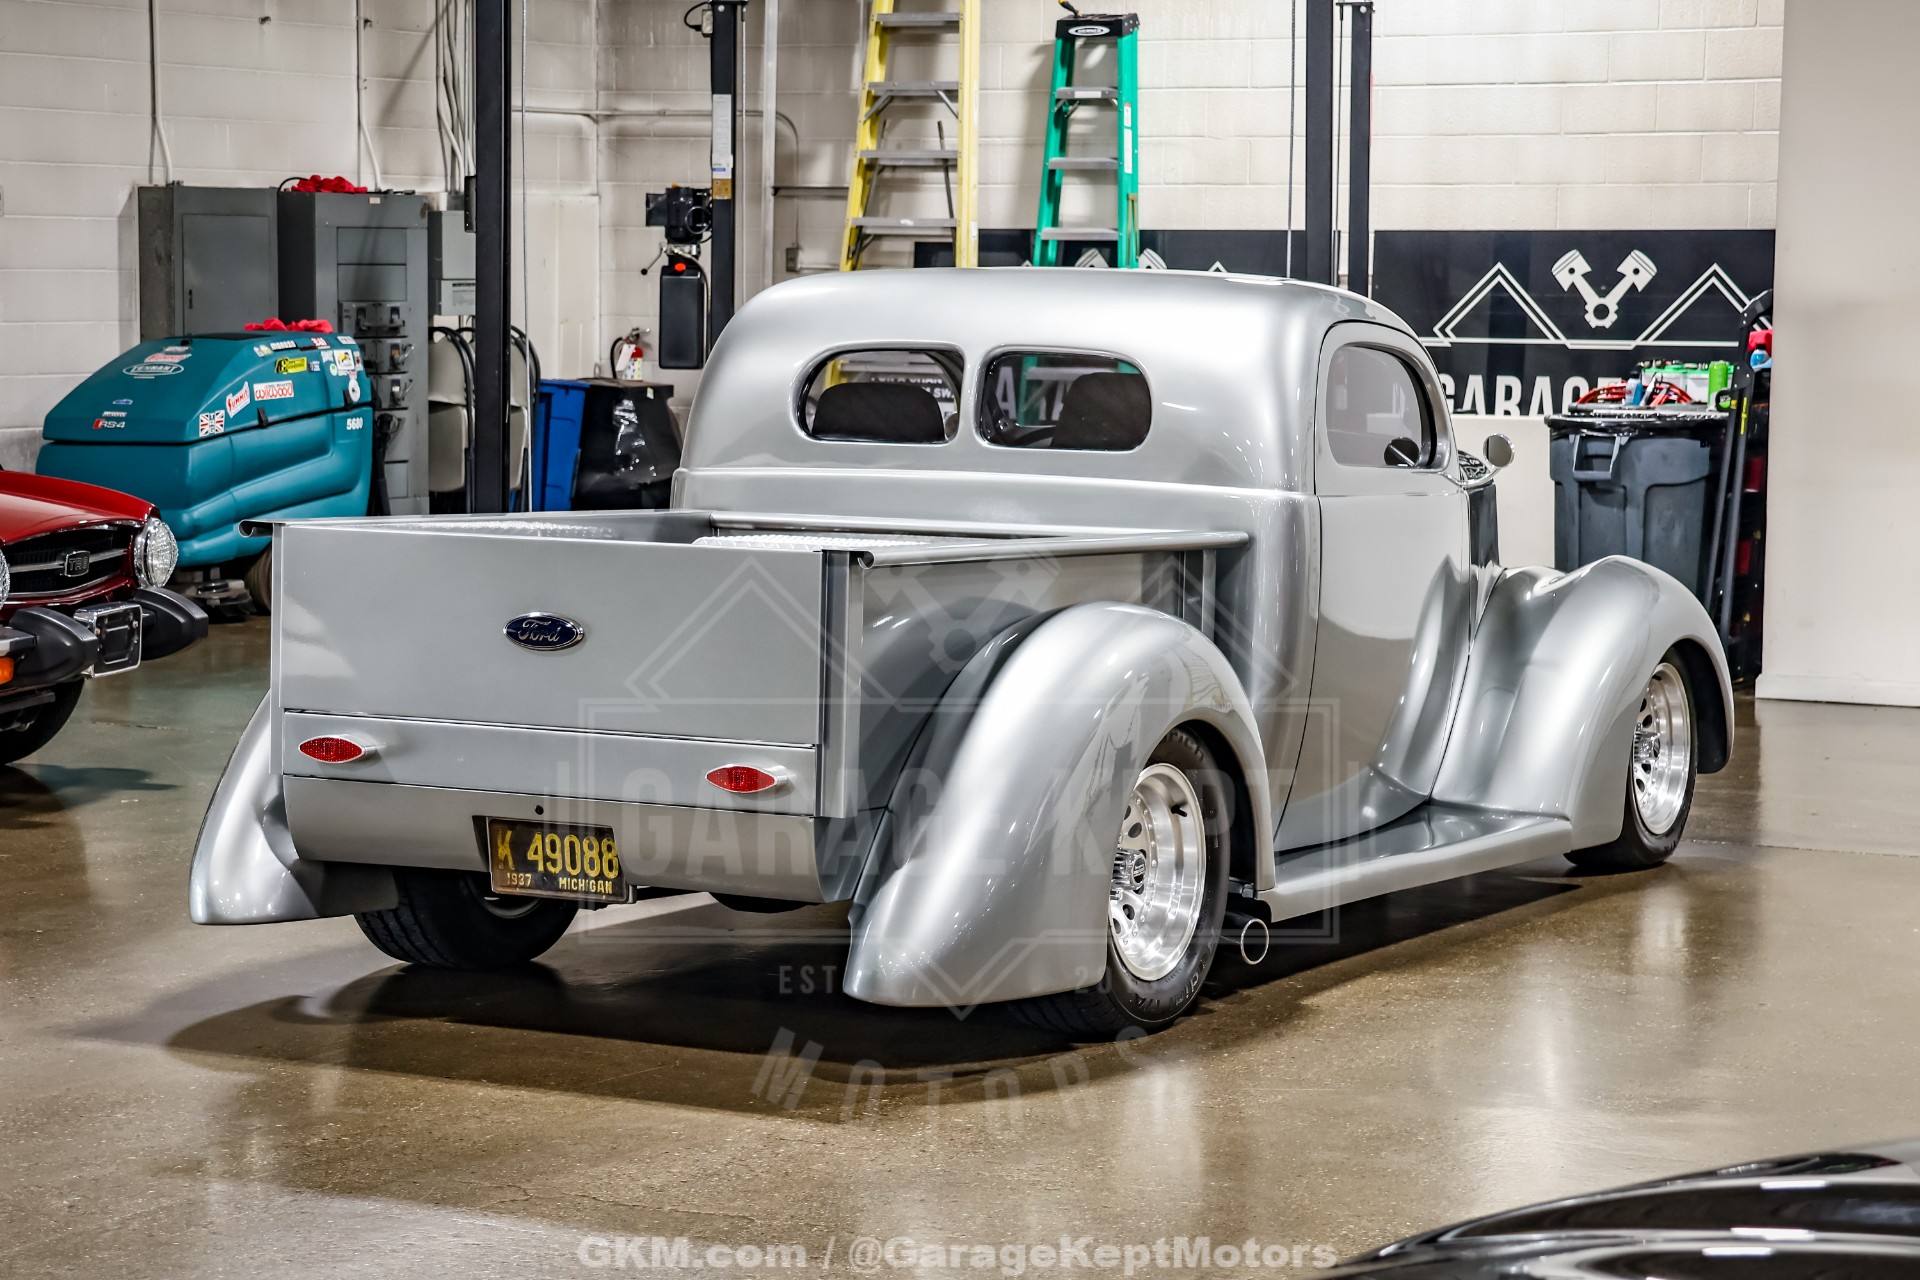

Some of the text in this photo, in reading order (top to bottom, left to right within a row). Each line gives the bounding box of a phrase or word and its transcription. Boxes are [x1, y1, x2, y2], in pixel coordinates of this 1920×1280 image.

[131, 365, 177, 373] TENNANT
[98, 419, 126, 429] RS4
[517, 618, 561, 643] Ford
[497, 829, 619, 879] K 49088
[506, 873, 613, 894] 1937 MICHIGAN
